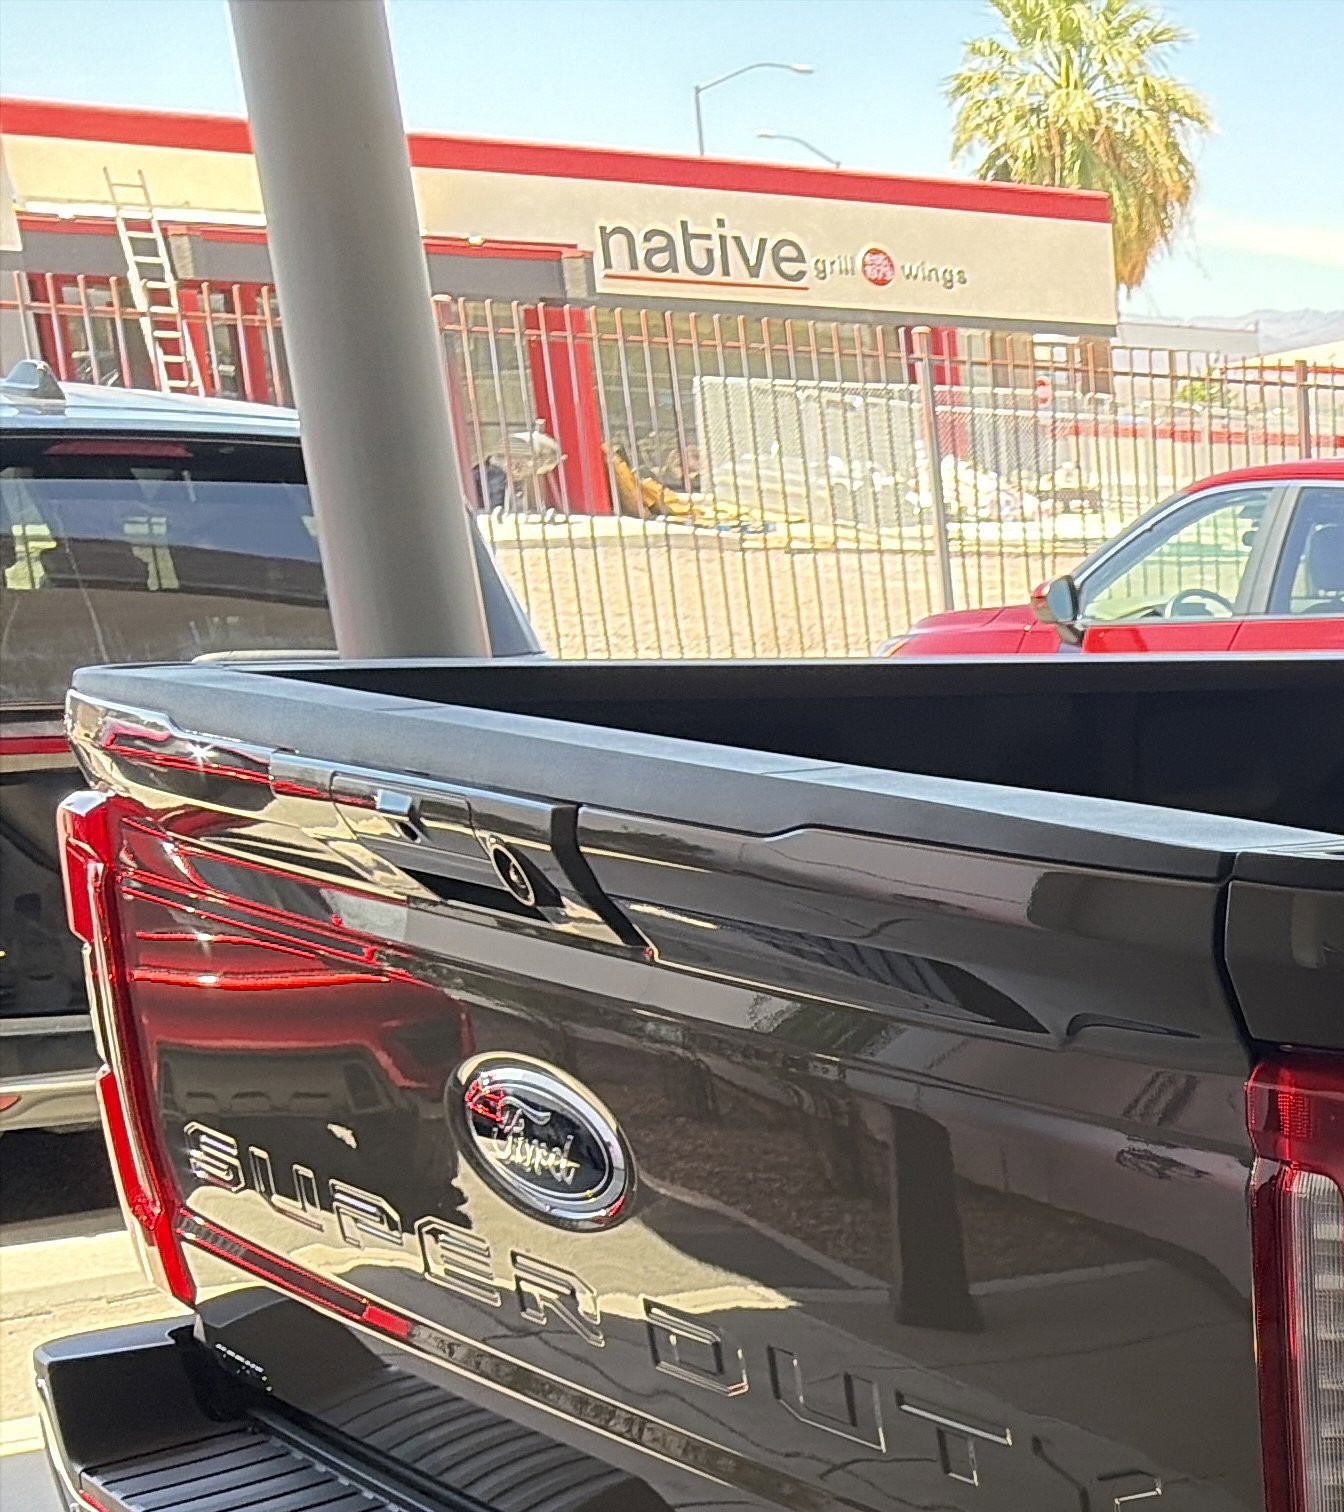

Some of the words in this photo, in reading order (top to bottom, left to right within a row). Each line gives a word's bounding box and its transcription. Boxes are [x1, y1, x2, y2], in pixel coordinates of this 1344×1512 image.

[599, 218, 807, 283] native
[813, 255, 856, 281] grill
[901, 261, 967, 290] wings
[184, 1121, 605, 1347] SUPER
